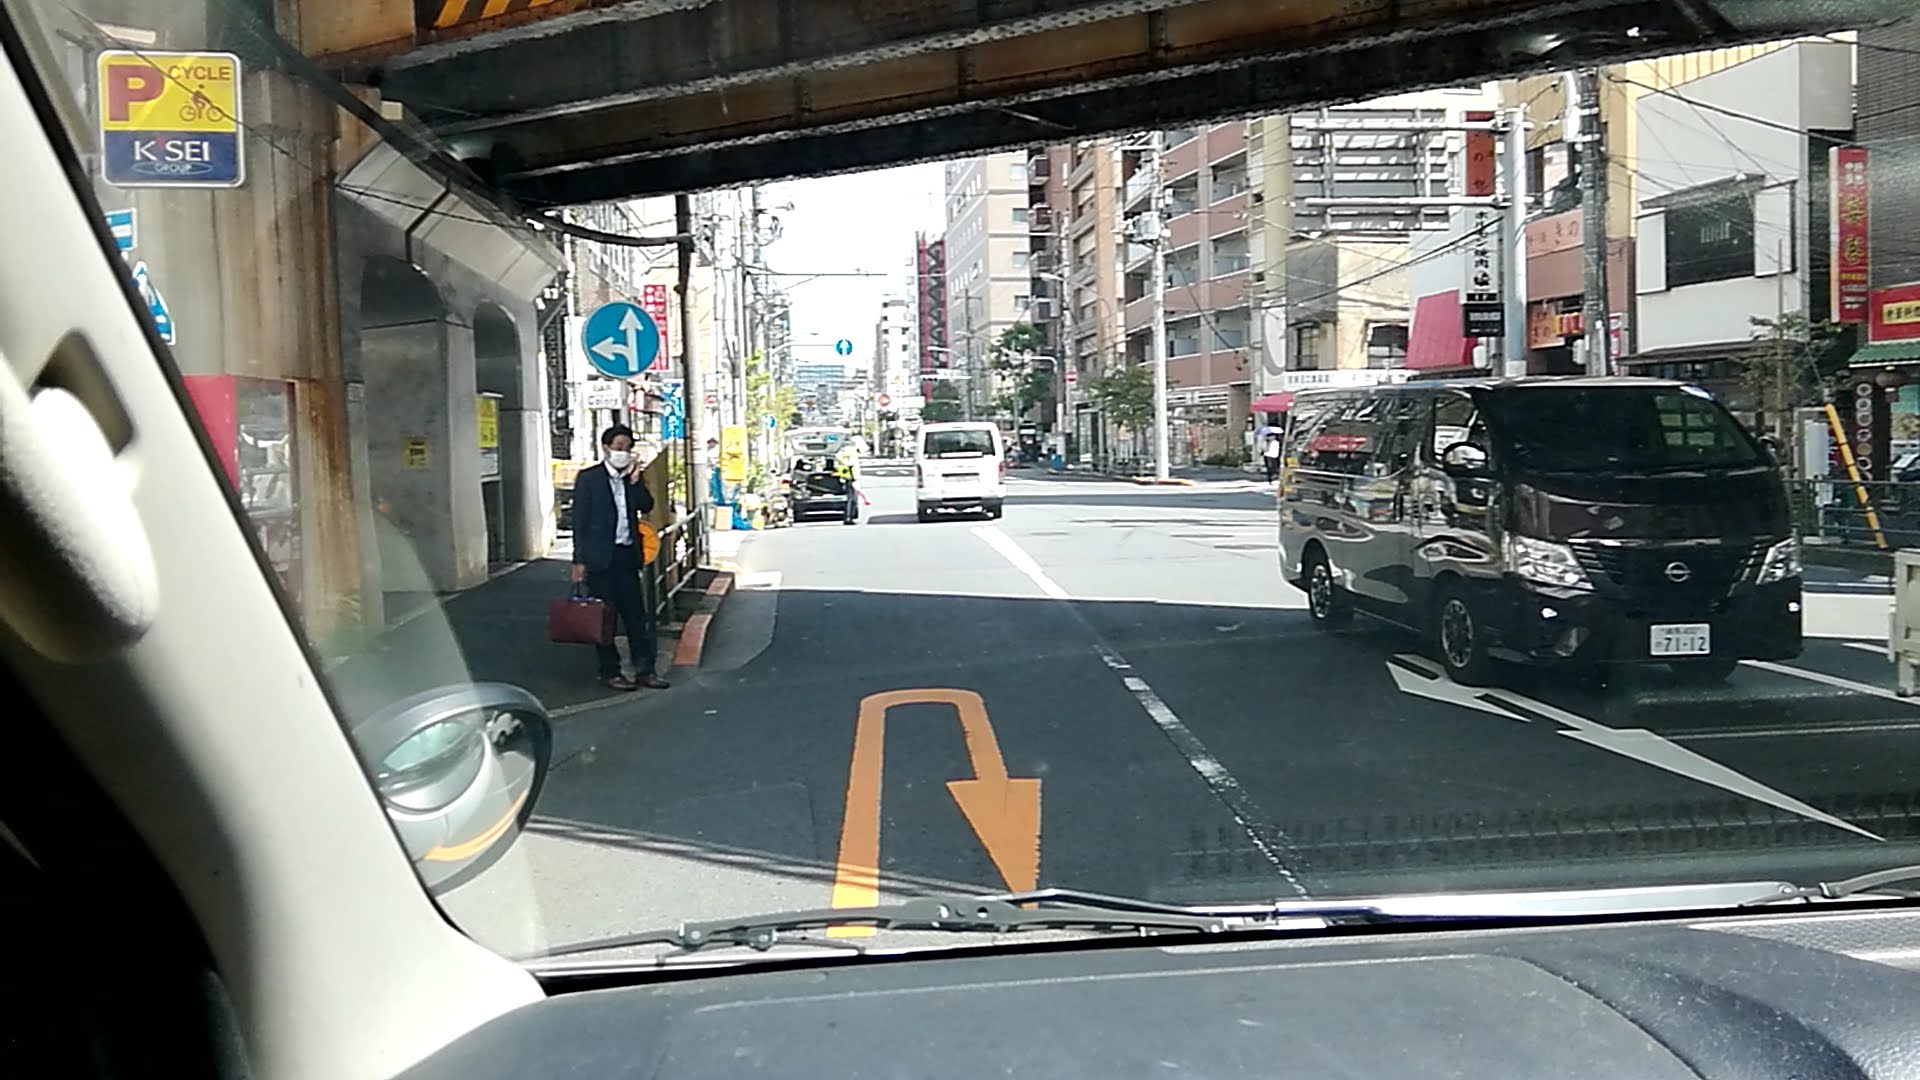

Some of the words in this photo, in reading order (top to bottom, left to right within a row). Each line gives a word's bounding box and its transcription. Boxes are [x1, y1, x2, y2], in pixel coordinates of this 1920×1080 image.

[108, 64, 165, 122] P
[168, 65, 231, 81] CYCLE
[154, 163, 192, 174] GROUP
[1664, 636, 1707, 652] 71-12
